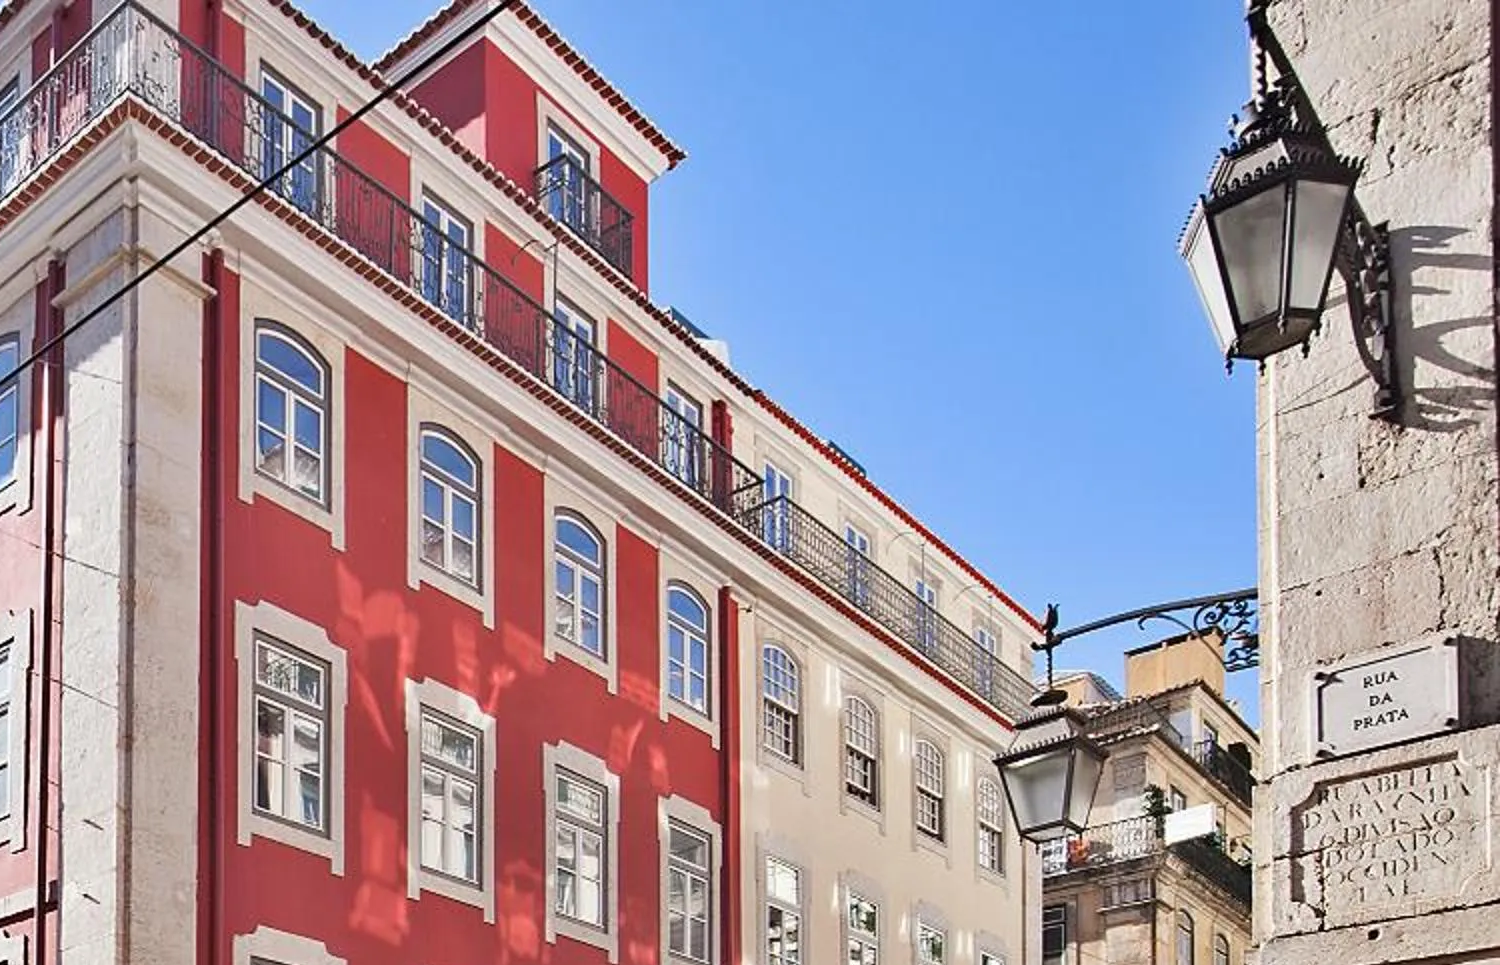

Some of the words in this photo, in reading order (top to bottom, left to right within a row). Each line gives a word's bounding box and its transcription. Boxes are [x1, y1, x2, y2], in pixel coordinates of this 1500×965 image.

[1363, 671, 1399, 689] RUA
[1369, 692, 1393, 707] DA
[1353, 708, 1409, 731] PRATA
